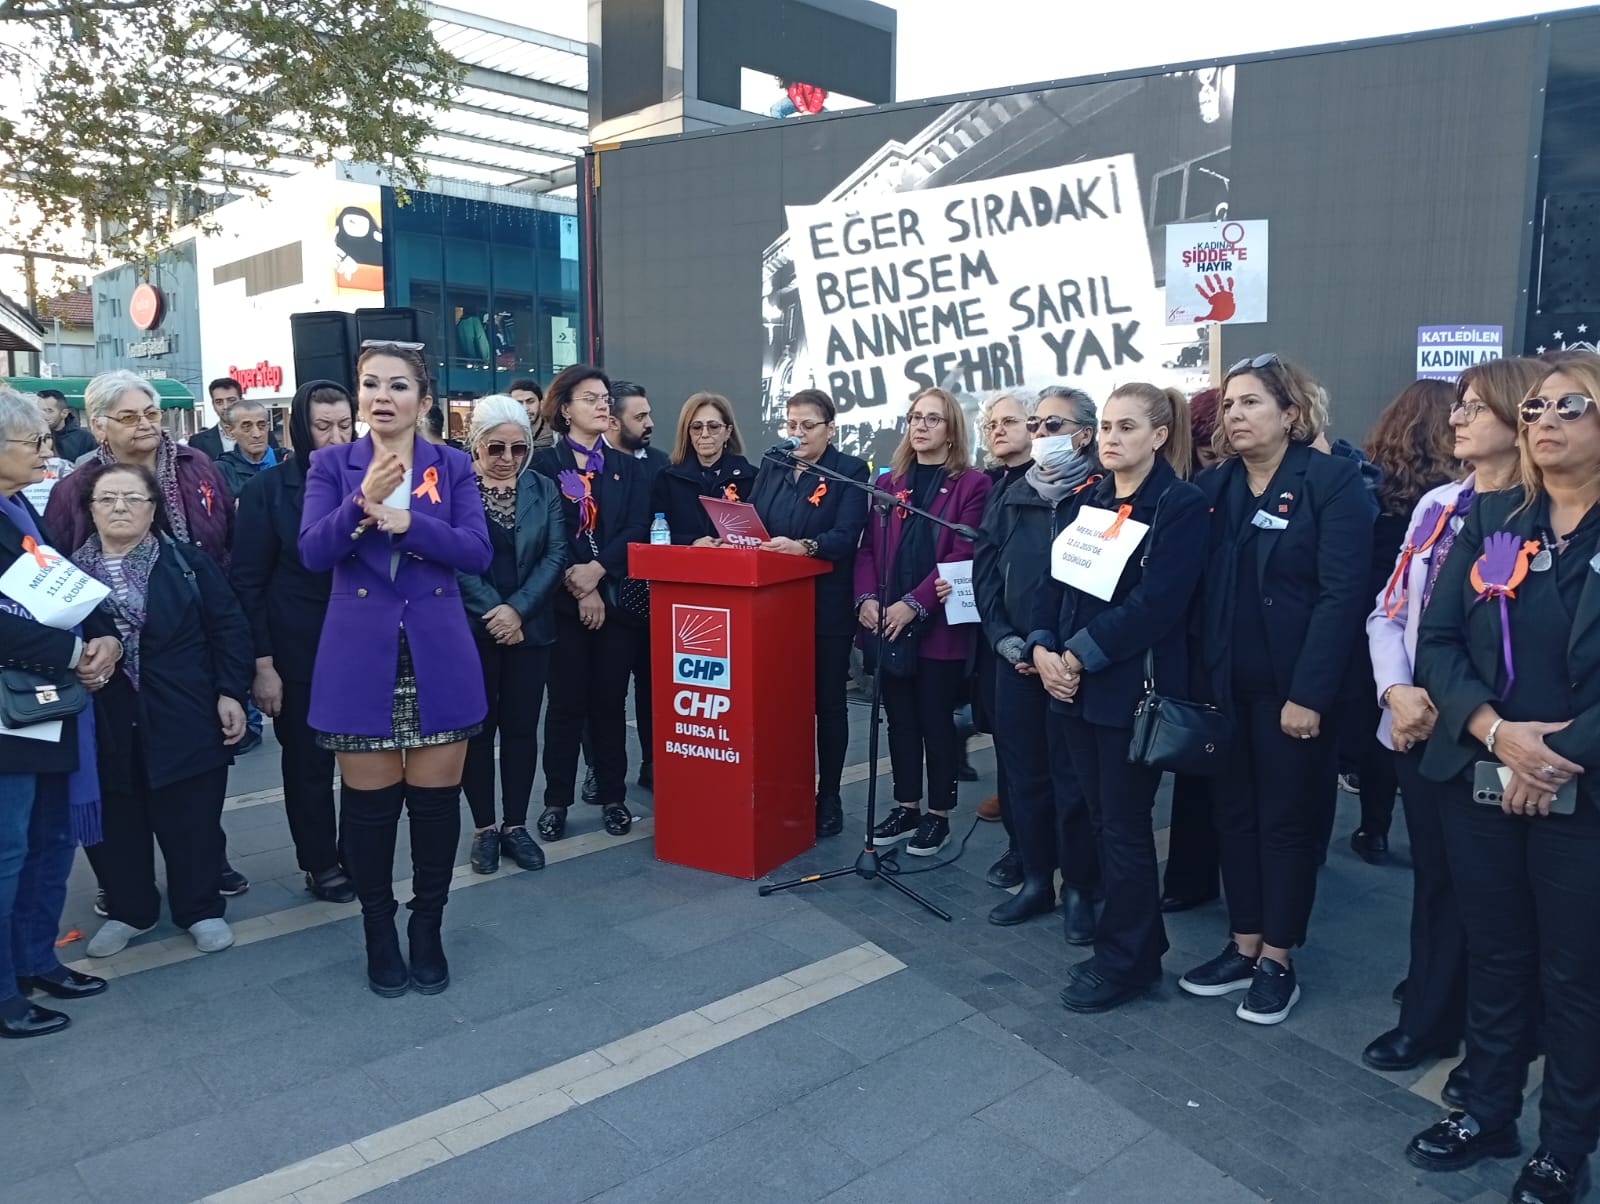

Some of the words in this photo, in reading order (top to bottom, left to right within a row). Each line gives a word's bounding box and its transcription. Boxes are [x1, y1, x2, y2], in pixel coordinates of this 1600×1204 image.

[809, 208, 925, 260] EĞER
[944, 164, 1122, 243] SIRADAKİ
[1197, 261, 1233, 272] HAYIR
[816, 249, 998, 315] BENSEM
[826, 298, 989, 366] ANNEME
[1009, 276, 1132, 332] SARIL
[1421, 329, 1500, 343] KATLEDİLEN
[229, 360, 283, 394] SuperStep
[828, 366, 888, 414] BU
[1041, 320, 1144, 377] YAK
[727, 533, 762, 546] CHP
[678, 658, 725, 680] CHP
[673, 690, 731, 720] CHP
[675, 722, 715, 740] BURSA
[718, 725, 730, 742] İL
[665, 741, 740, 764] BAŞKANLIĞI
